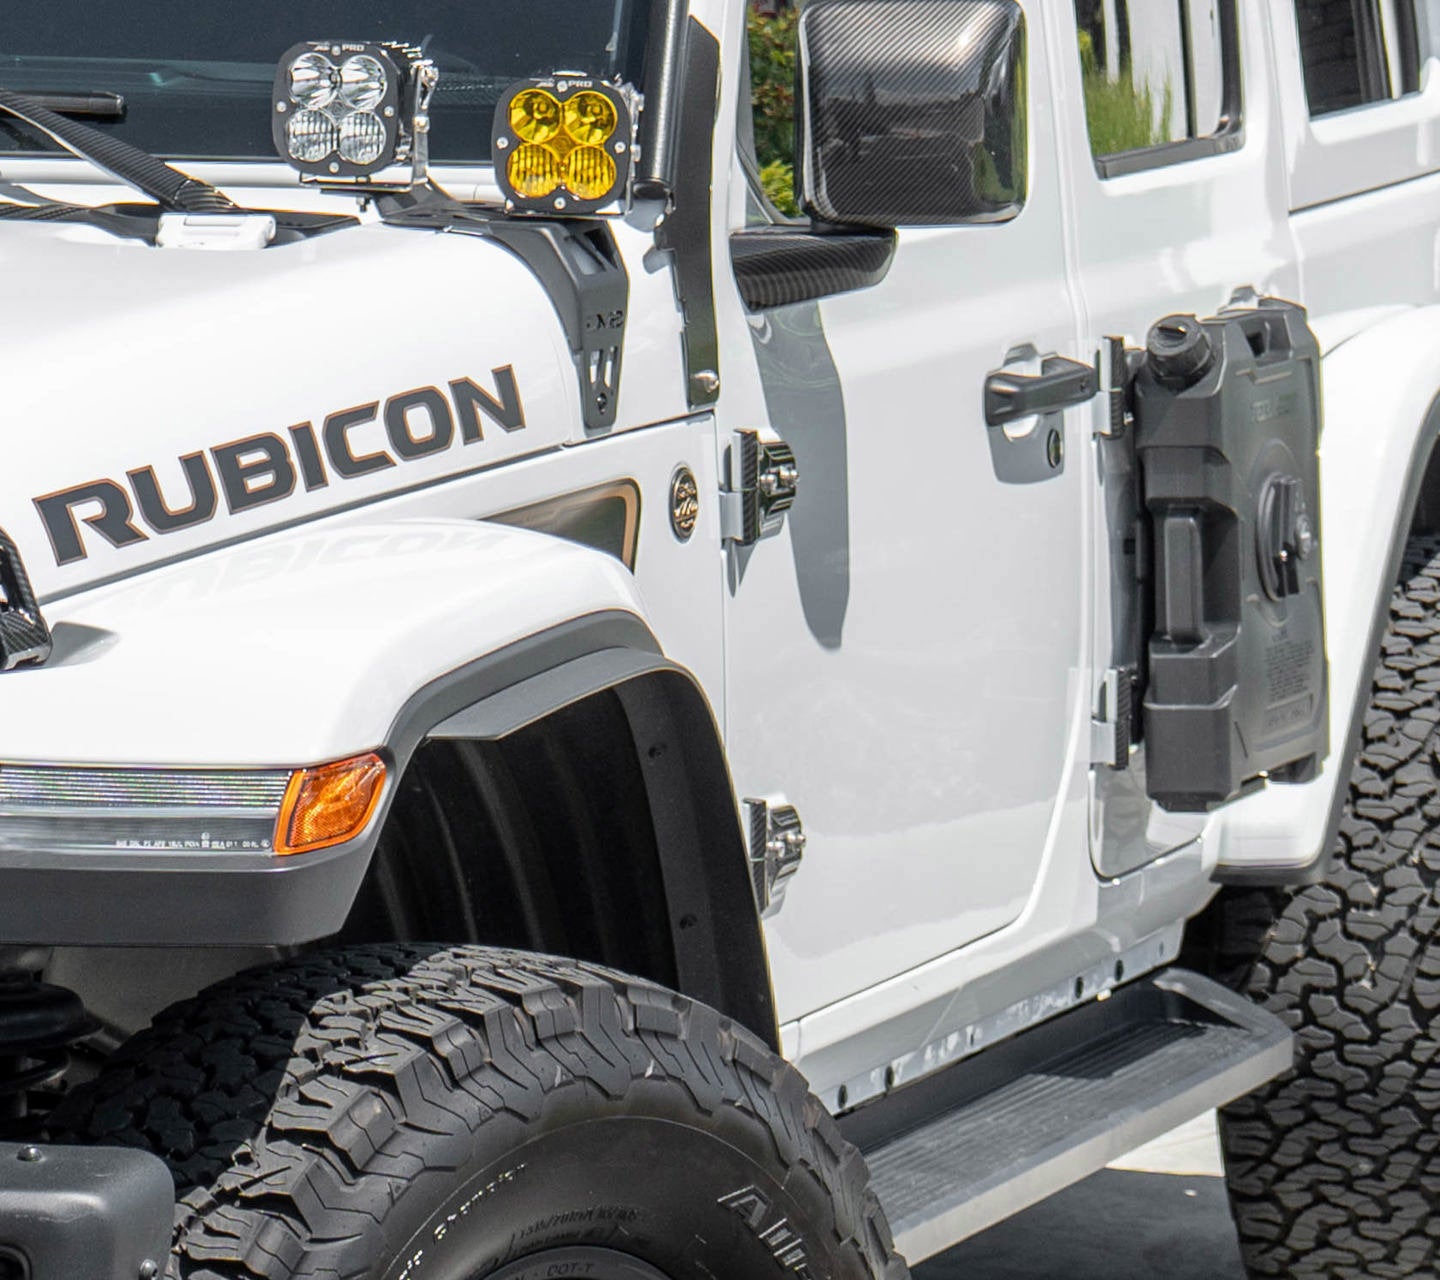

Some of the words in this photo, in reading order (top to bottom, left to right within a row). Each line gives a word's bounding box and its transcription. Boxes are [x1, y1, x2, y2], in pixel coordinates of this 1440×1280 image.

[342, 43, 364, 52] PRO
[568, 80, 592, 88] PRO
[32, 364, 526, 567] RUBICON
